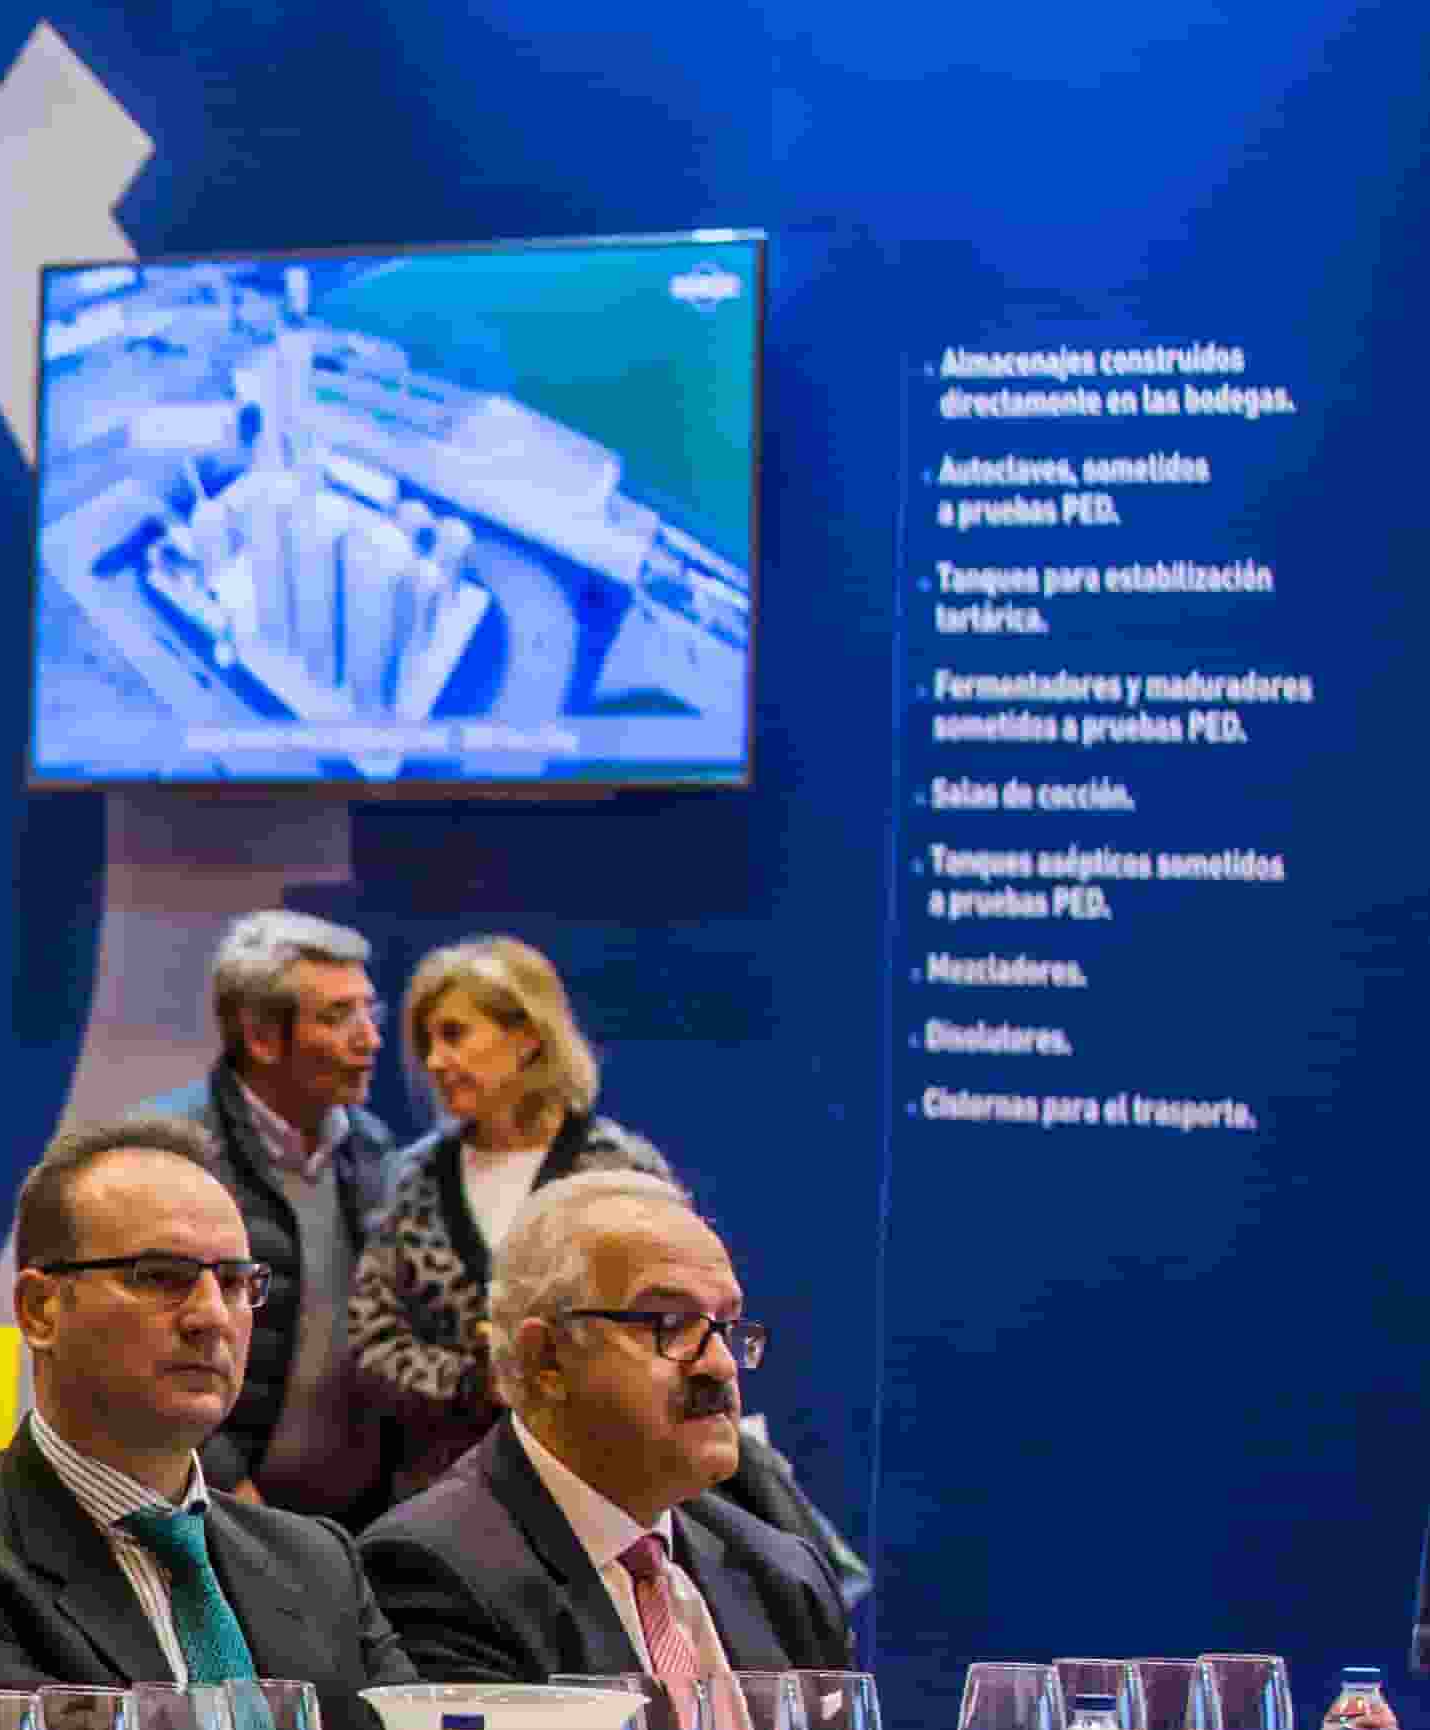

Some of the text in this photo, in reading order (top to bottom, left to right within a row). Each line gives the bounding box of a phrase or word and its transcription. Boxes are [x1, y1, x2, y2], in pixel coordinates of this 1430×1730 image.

[939, 344, 1245, 381] Almacenajes construidos
[940, 385, 1296, 419] directamente en las bodegas.
[939, 453, 1210, 485] Autoclaves, sometidos
[959, 497, 1057, 530] pruebas
[1062, 494, 1119, 524] PED.
[936, 560, 1274, 597] Tanques para estabilización
[935, 603, 1048, 633] tartárica.
[934, 670, 1122, 702] Fermentadores
[1146, 671, 1313, 701] maduradores
[934, 710, 1058, 743] sometidos
[1082, 712, 1183, 745] pruebas
[1188, 711, 1247, 742] PED.
[931, 777, 1135, 810] Salas de cocción.
[930, 844, 1285, 881] Tanques asépticos sometidos
[950, 888, 1048, 920] pruebas
[1053, 886, 1111, 918] PED.
[927, 953, 1087, 987] Mezcladores.
[924, 1020, 1071, 1055] Disolutores.
[922, 1087, 1039, 1123] Cisternas
[1042, 1096, 1100, 1126] para
